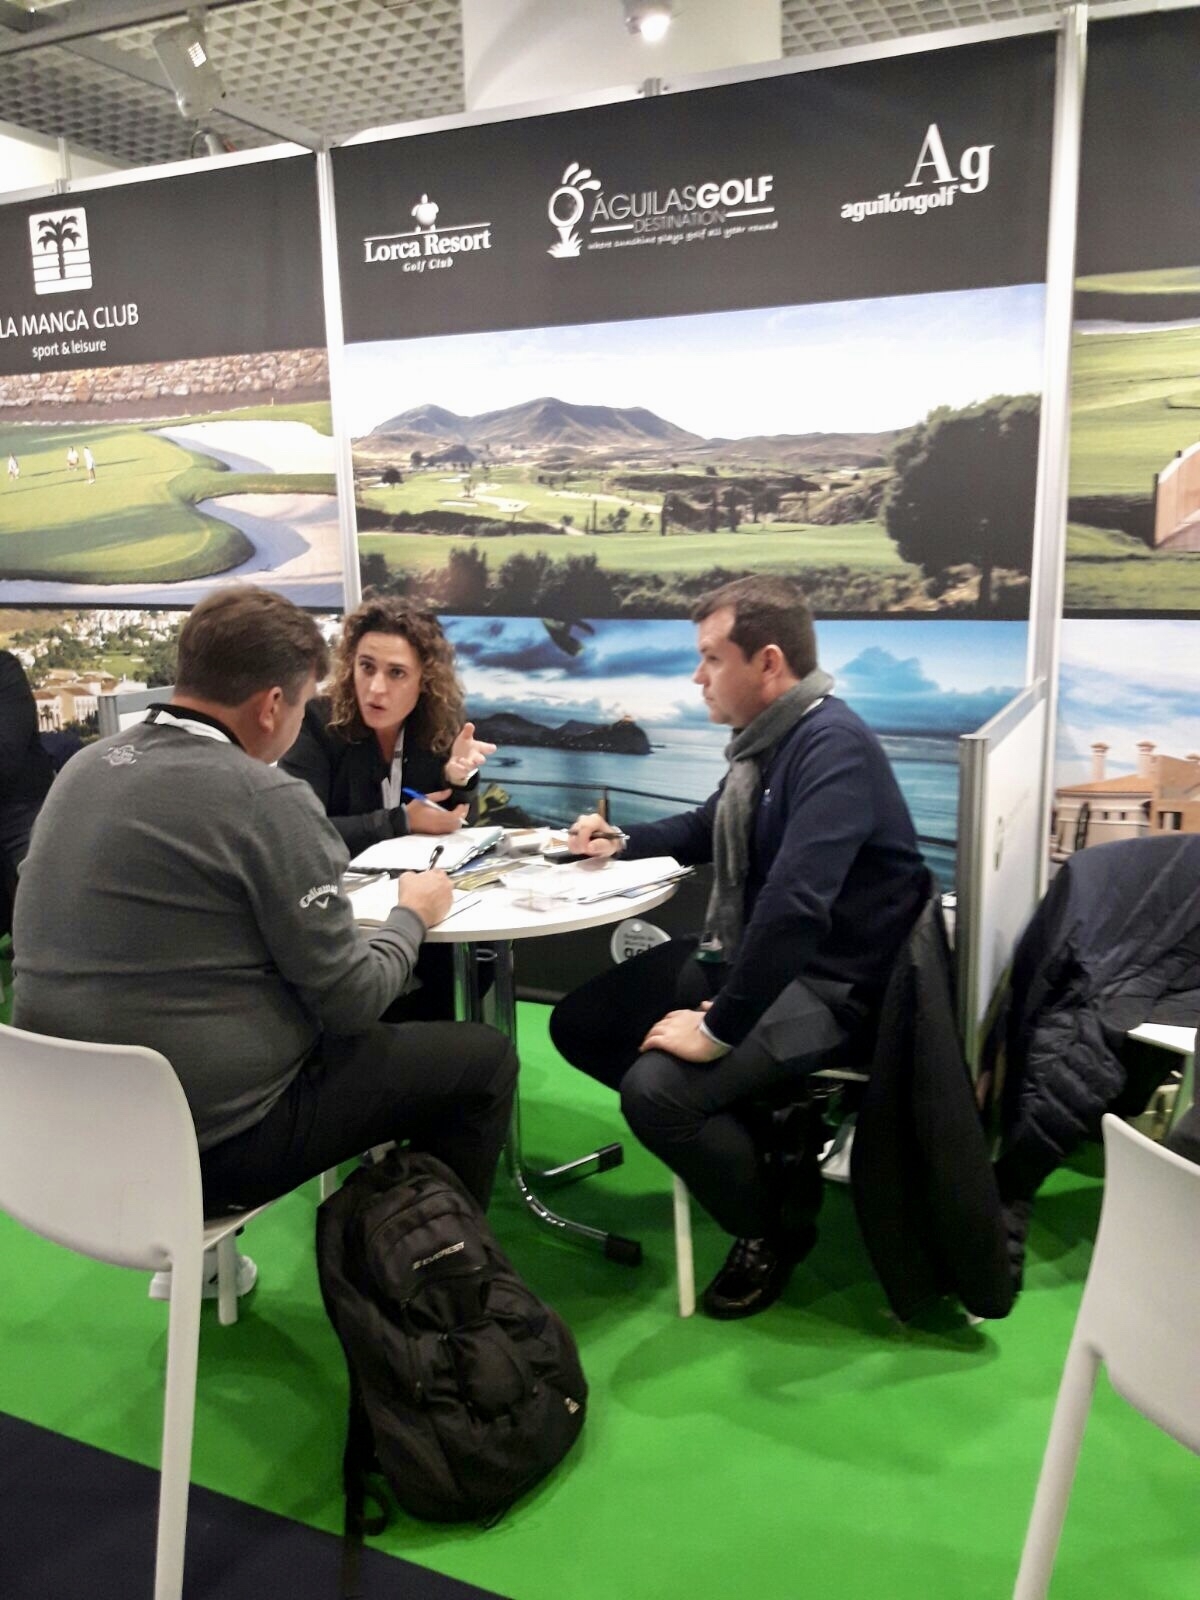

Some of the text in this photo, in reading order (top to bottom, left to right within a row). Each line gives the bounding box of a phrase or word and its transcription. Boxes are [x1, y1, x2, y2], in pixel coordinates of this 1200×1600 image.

[904, 123, 996, 194] Ag
[840, 184, 960, 222] aguilóngolf
[633, 209, 727, 234] DESTINATION
[364, 229, 492, 263] Lorca Resort
[403, 256, 454, 273] Golf Club
[0, 303, 139, 339] LA MANGA CLUB
[32, 338, 107, 361] sport & leisure
